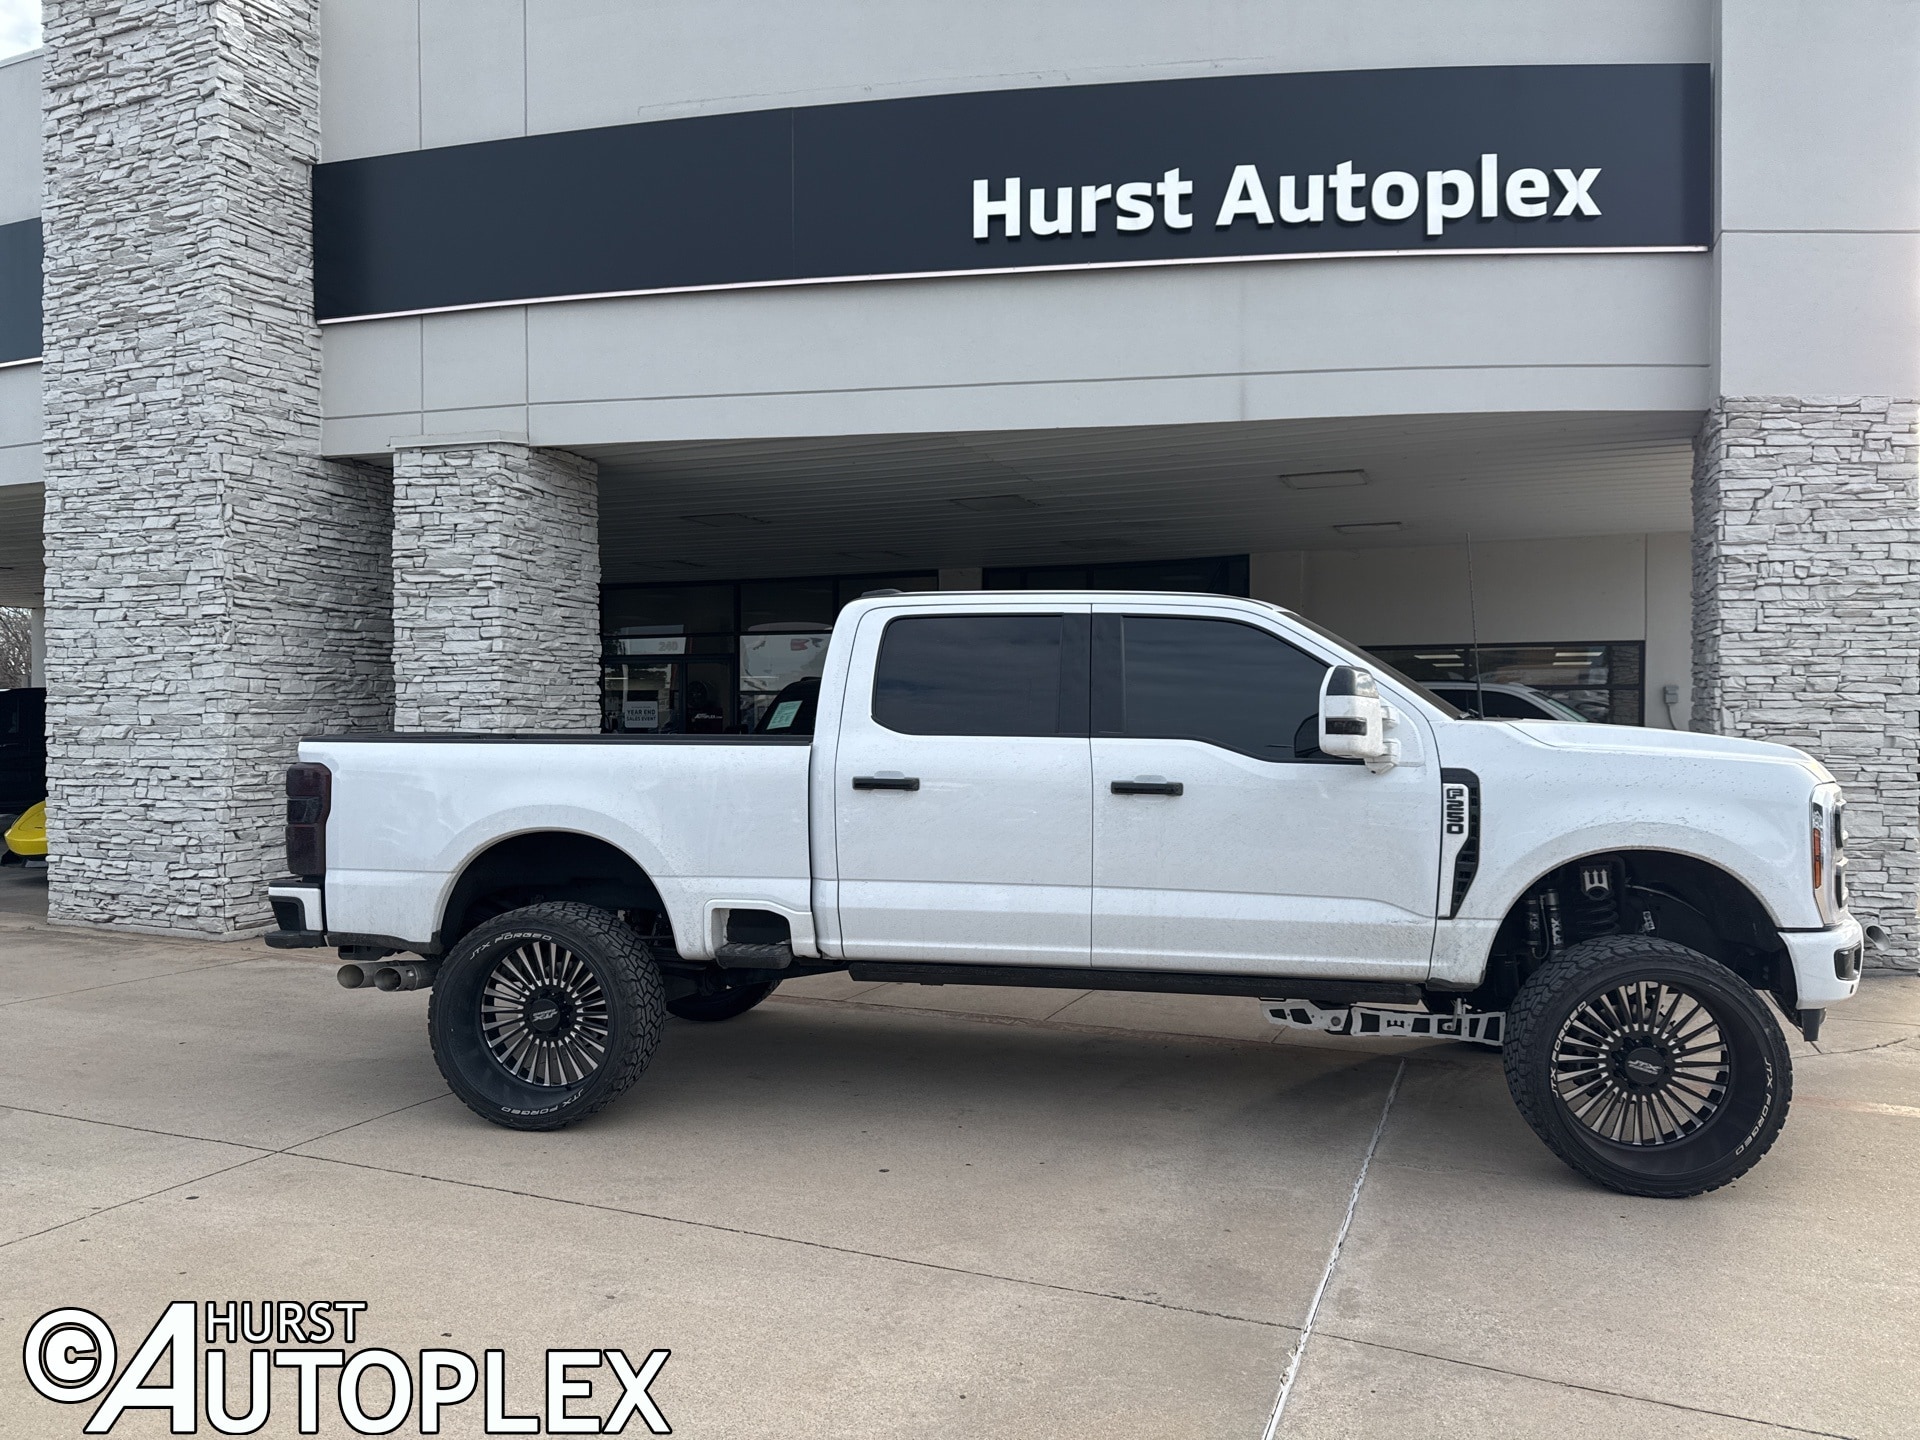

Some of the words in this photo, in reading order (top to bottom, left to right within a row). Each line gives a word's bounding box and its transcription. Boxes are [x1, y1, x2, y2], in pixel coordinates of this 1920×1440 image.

[972, 167, 1193, 238] Hurst
[1215, 153, 1602, 235] Autoplex
[1446, 788, 1464, 834] F250
[469, 941, 491, 960] JTX
[495, 931, 552, 944] FORGED
[1551, 1001, 1587, 1063] FORGED
[1550, 1067, 1559, 1098] JTX
[1764, 1056, 1773, 1089] JTX
[501, 1105, 559, 1116] FORGED
[562, 1088, 584, 1108] JTX
[1735, 1093, 1772, 1156] FORGED
